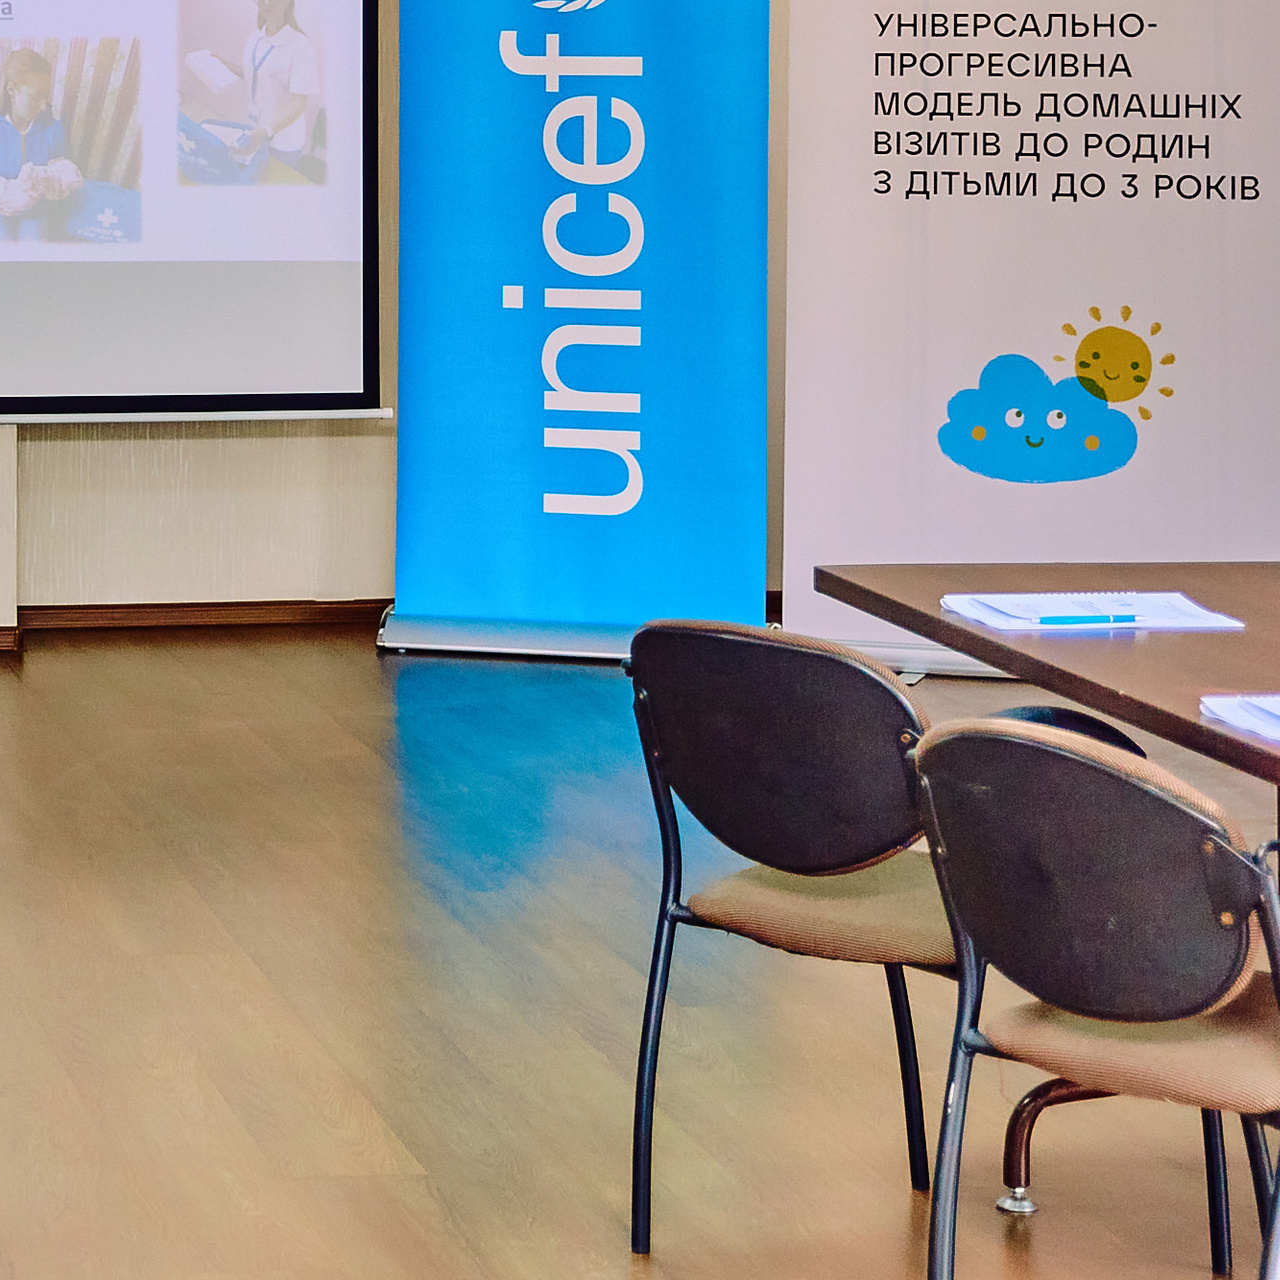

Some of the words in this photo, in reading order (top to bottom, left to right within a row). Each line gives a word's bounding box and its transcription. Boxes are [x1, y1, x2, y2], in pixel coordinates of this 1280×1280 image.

[874, 12, 1158, 39] УНІВЕРСАЛЬНО-
[874, 52, 1133, 78] ПРОГРЕСИВНА
[874, 91, 1022, 121] МОДЕЛЬ
[1035, 92, 1243, 122] ДОМАШНІХ
[874, 131, 1001, 157] ВІЗИТІВ
[1015, 132, 1068, 163] ДО
[1084, 133, 1211, 164] РОДИН
[873, 170, 893, 195] З
[905, 170, 1038, 201] ДІТЬМИ
[1051, 172, 1105, 203] ДО
[1120, 172, 1139, 199] 3
[1154, 174, 1261, 201] РОКІВ
[498, 28, 646, 517] unicef
